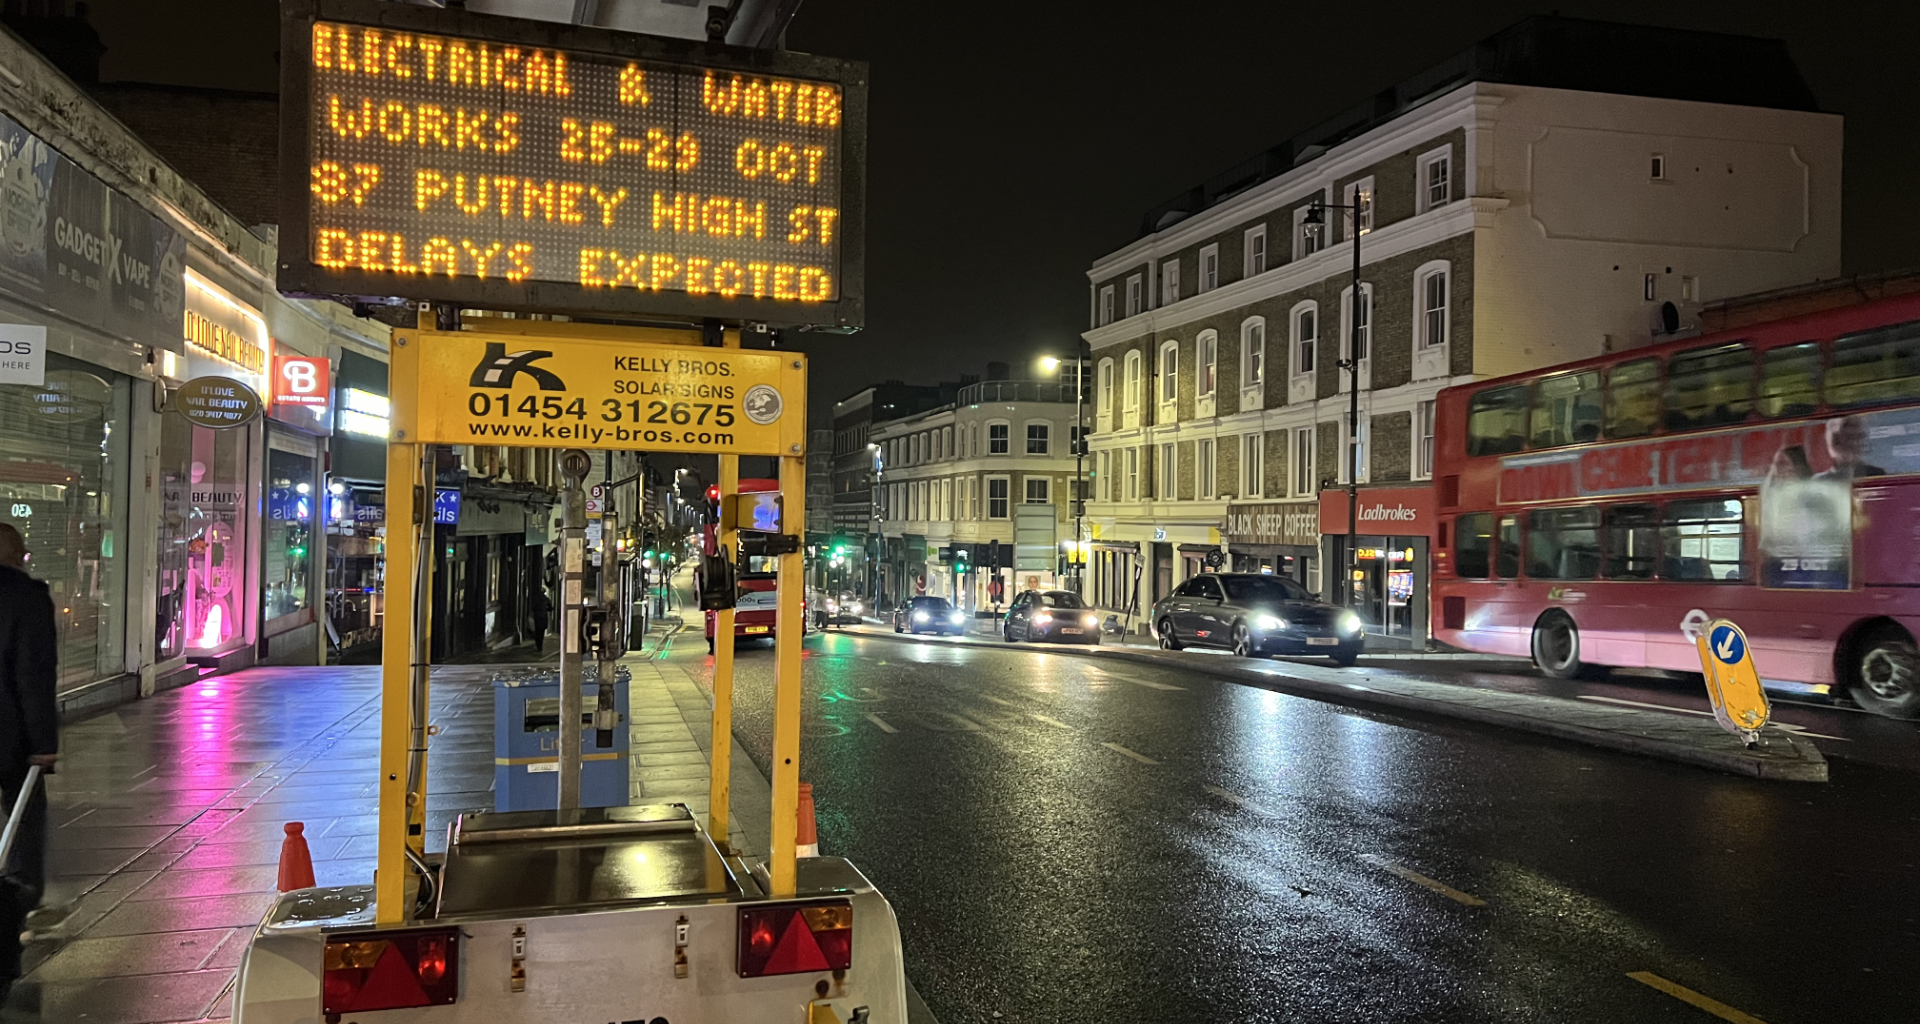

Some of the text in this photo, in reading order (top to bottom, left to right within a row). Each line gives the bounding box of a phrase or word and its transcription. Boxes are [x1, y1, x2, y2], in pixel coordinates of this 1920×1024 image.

[313, 23, 840, 127] ELECTRICAL & WATER
[331, 96, 823, 185] WORKS 25-29 OCT
[416, 169, 626, 227] PUTNEY
[652, 192, 765, 240] HIGH
[787, 206, 837, 246] ST
[55, 216, 108, 267] GADGET
[107, 233, 122, 285] X
[123, 252, 150, 289] VAPE
[317, 229, 830, 301] DELAYS EXPECTED
[2, 361, 31, 370] HERE
[283, 360, 316, 393] B
[614, 356, 735, 377] KELLY BROS.
[613, 380, 735, 399] SOLAR SIGNS
[208, 399, 248, 409] BEAUTY
[468, 392, 735, 427] 01454 312675
[468, 422, 734, 445] www.kelly-bros.com
[192, 492, 243, 503] BEAUTY
[593, 487, 600, 496] B
[437, 507, 455, 522] ils
[1358, 503, 1417, 521] Ladbrokes
[1228, 513, 1316, 537] BLACK SHEEP COFFEE
